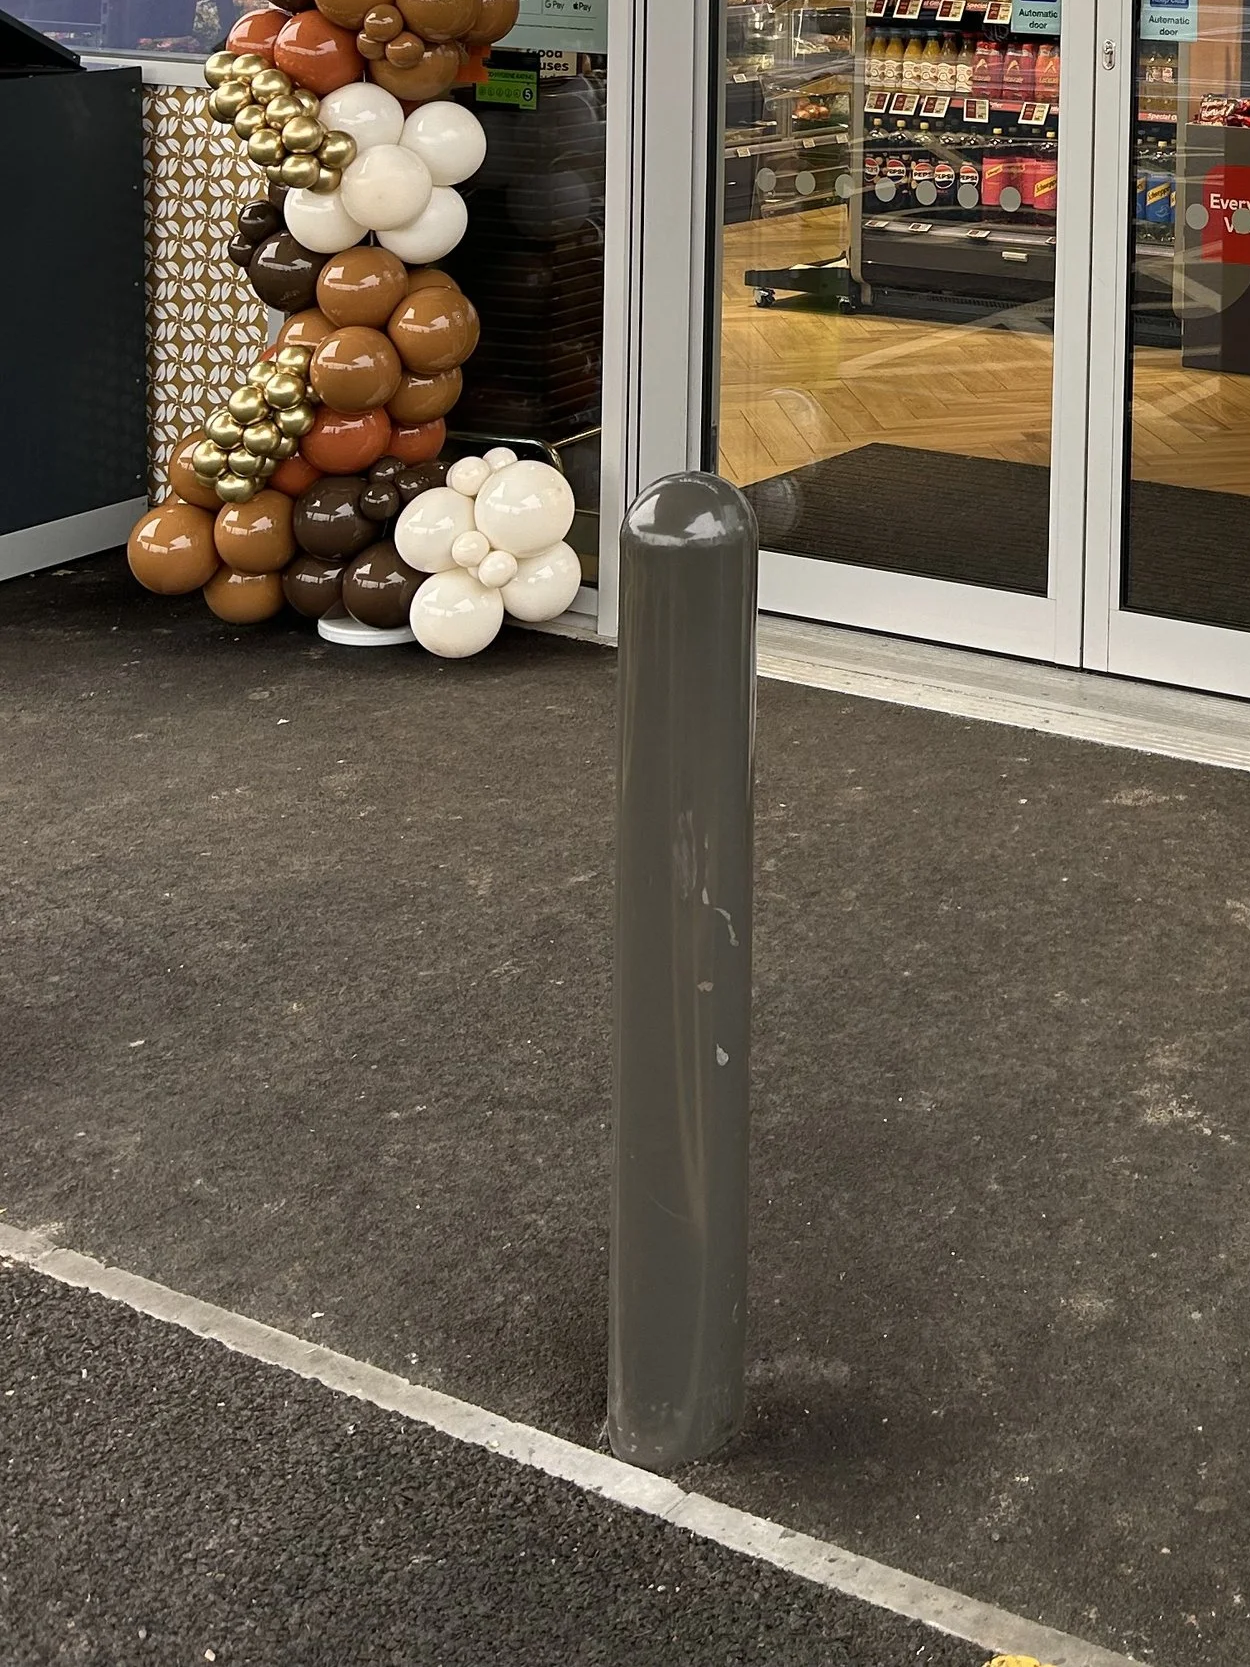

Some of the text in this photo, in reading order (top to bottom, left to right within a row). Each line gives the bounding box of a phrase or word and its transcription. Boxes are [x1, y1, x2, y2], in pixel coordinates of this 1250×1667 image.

[552, 0, 565, 11] Pay
[1018, 8, 1058, 19] Automatic
[1028, 20, 1048, 30] door
[1148, 15, 1190, 25] Automatic
[1159, 27, 1179, 36] door
[524, 89, 533, 101] 5
